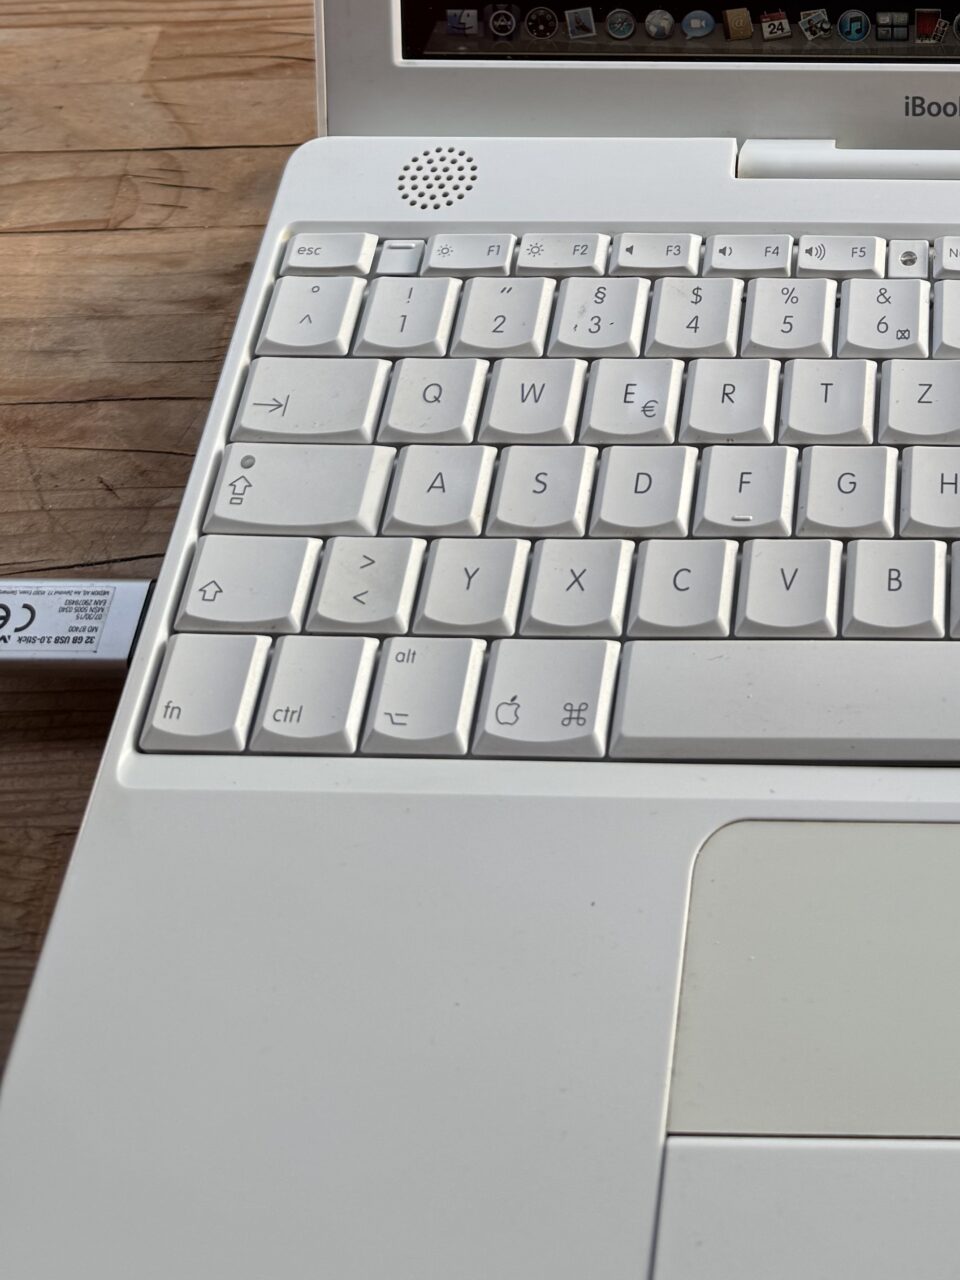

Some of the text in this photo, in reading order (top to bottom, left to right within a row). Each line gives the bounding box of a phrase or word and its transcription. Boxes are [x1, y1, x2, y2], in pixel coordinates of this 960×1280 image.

[767, 21, 785, 35] 24
[297, 245, 322, 256] esc
[487, 244, 501, 255] F1
[572, 244, 589, 255] F2
[665, 244, 682, 256] F3
[764, 245, 780, 257] F4
[850, 246, 867, 258] F5
[422, 382, 444, 405] Q
[520, 382, 546, 404] W
[623, 383, 638, 404] E
[720, 383, 737, 404] R
[819, 383, 834, 403] T
[917, 383, 934, 405] Z
[426, 472, 447, 494] A
[532, 472, 548, 494] S
[634, 472, 653, 494] D
[737, 472, 753, 494] F
[837, 472, 857, 494] G
[940, 472, 959, 494] H
[54, 636, 71, 644] USB
[72, 636, 84, 644] GB
[84, 636, 96, 644] 32
[395, 649, 417, 665] alt
[162, 700, 182, 722] fn
[272, 705, 303, 724] ctrl
